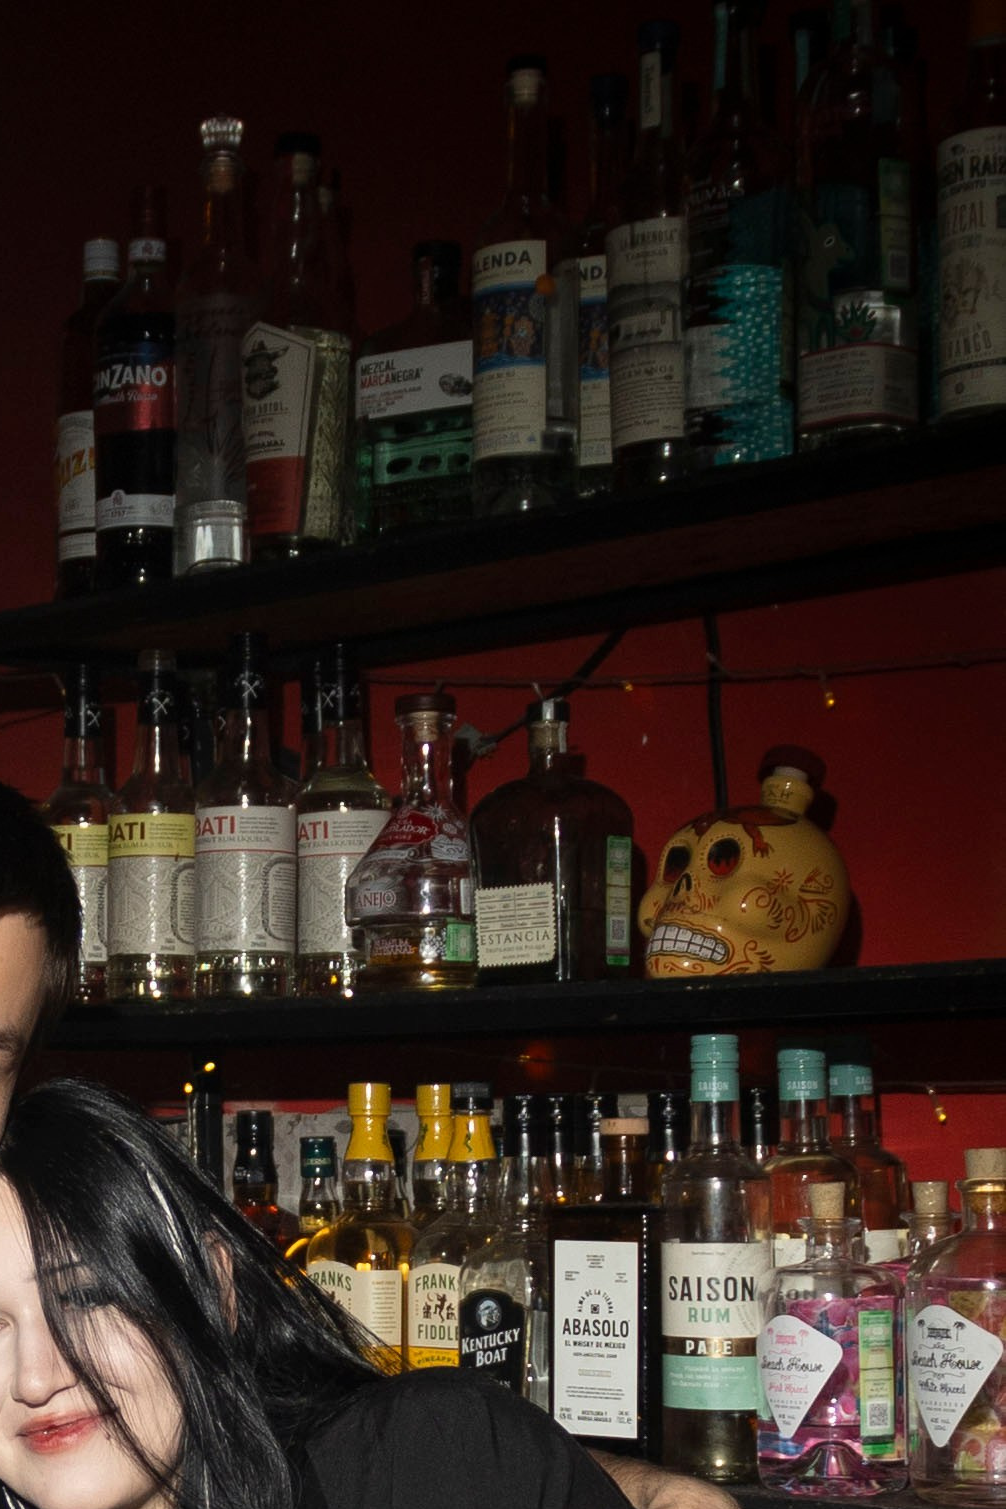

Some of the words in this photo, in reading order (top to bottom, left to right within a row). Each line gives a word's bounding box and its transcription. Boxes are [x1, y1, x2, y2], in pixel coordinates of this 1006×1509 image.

[360, 359, 396, 376] MEZCAL
[355, 887, 397, 909] AÑEJO
[480, 930, 550, 946] ESTANCIA
[415, 1273, 457, 1294] FRANK
[668, 1275, 755, 1302] SAISON
[688, 1307, 731, 1324] RUM
[562, 1318, 629, 1338] ABASOLO
[461, 1327, 521, 1355] KENTUCKY
[475, 1347, 508, 1367] BOAT
[940, 1352, 984, 1371] House
